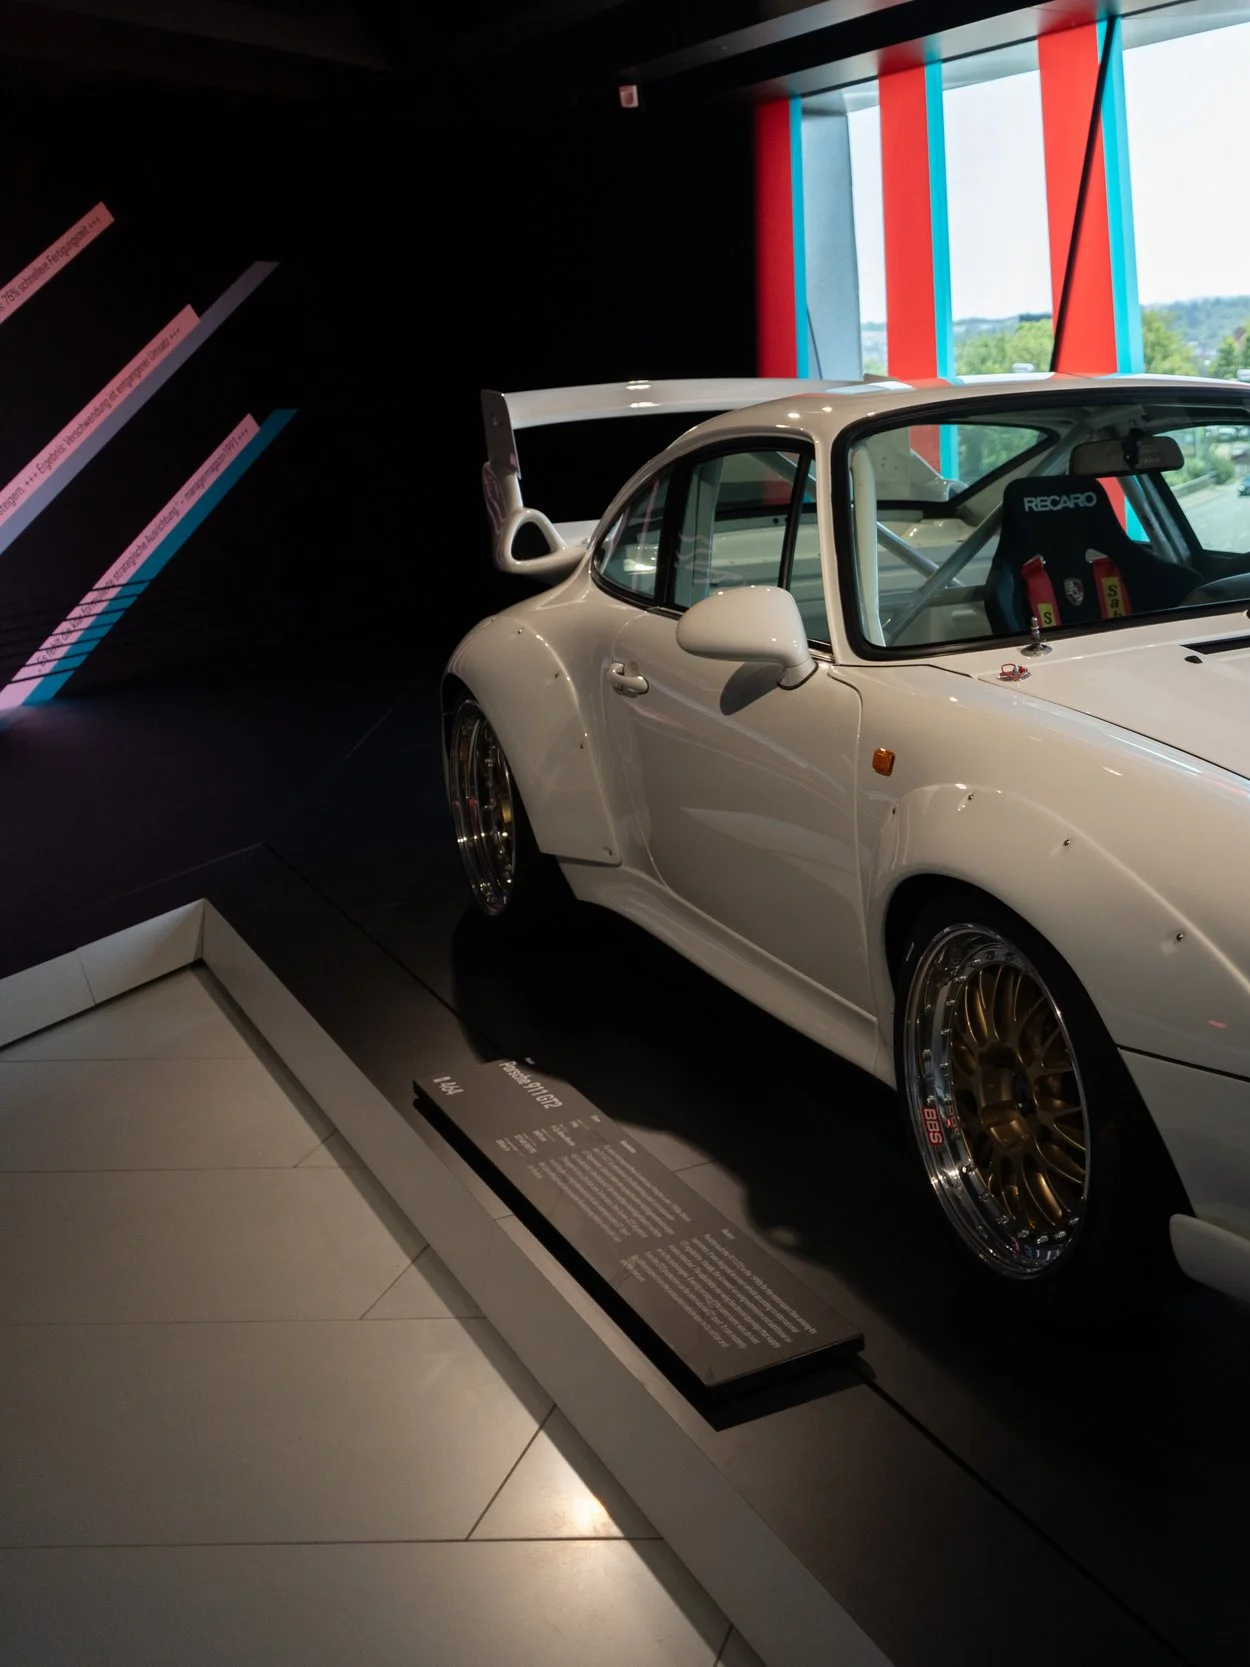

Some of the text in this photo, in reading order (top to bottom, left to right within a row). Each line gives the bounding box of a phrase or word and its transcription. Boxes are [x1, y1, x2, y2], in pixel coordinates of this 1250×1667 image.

[1023, 491, 1098, 512] RECARO
[498, 1060, 531, 1086] Porsche
[438, 1081, 464, 1096] 464
[523, 1081, 549, 1099] 911
[535, 1093, 564, 1110] GT2
[923, 1108, 942, 1144] BBS
